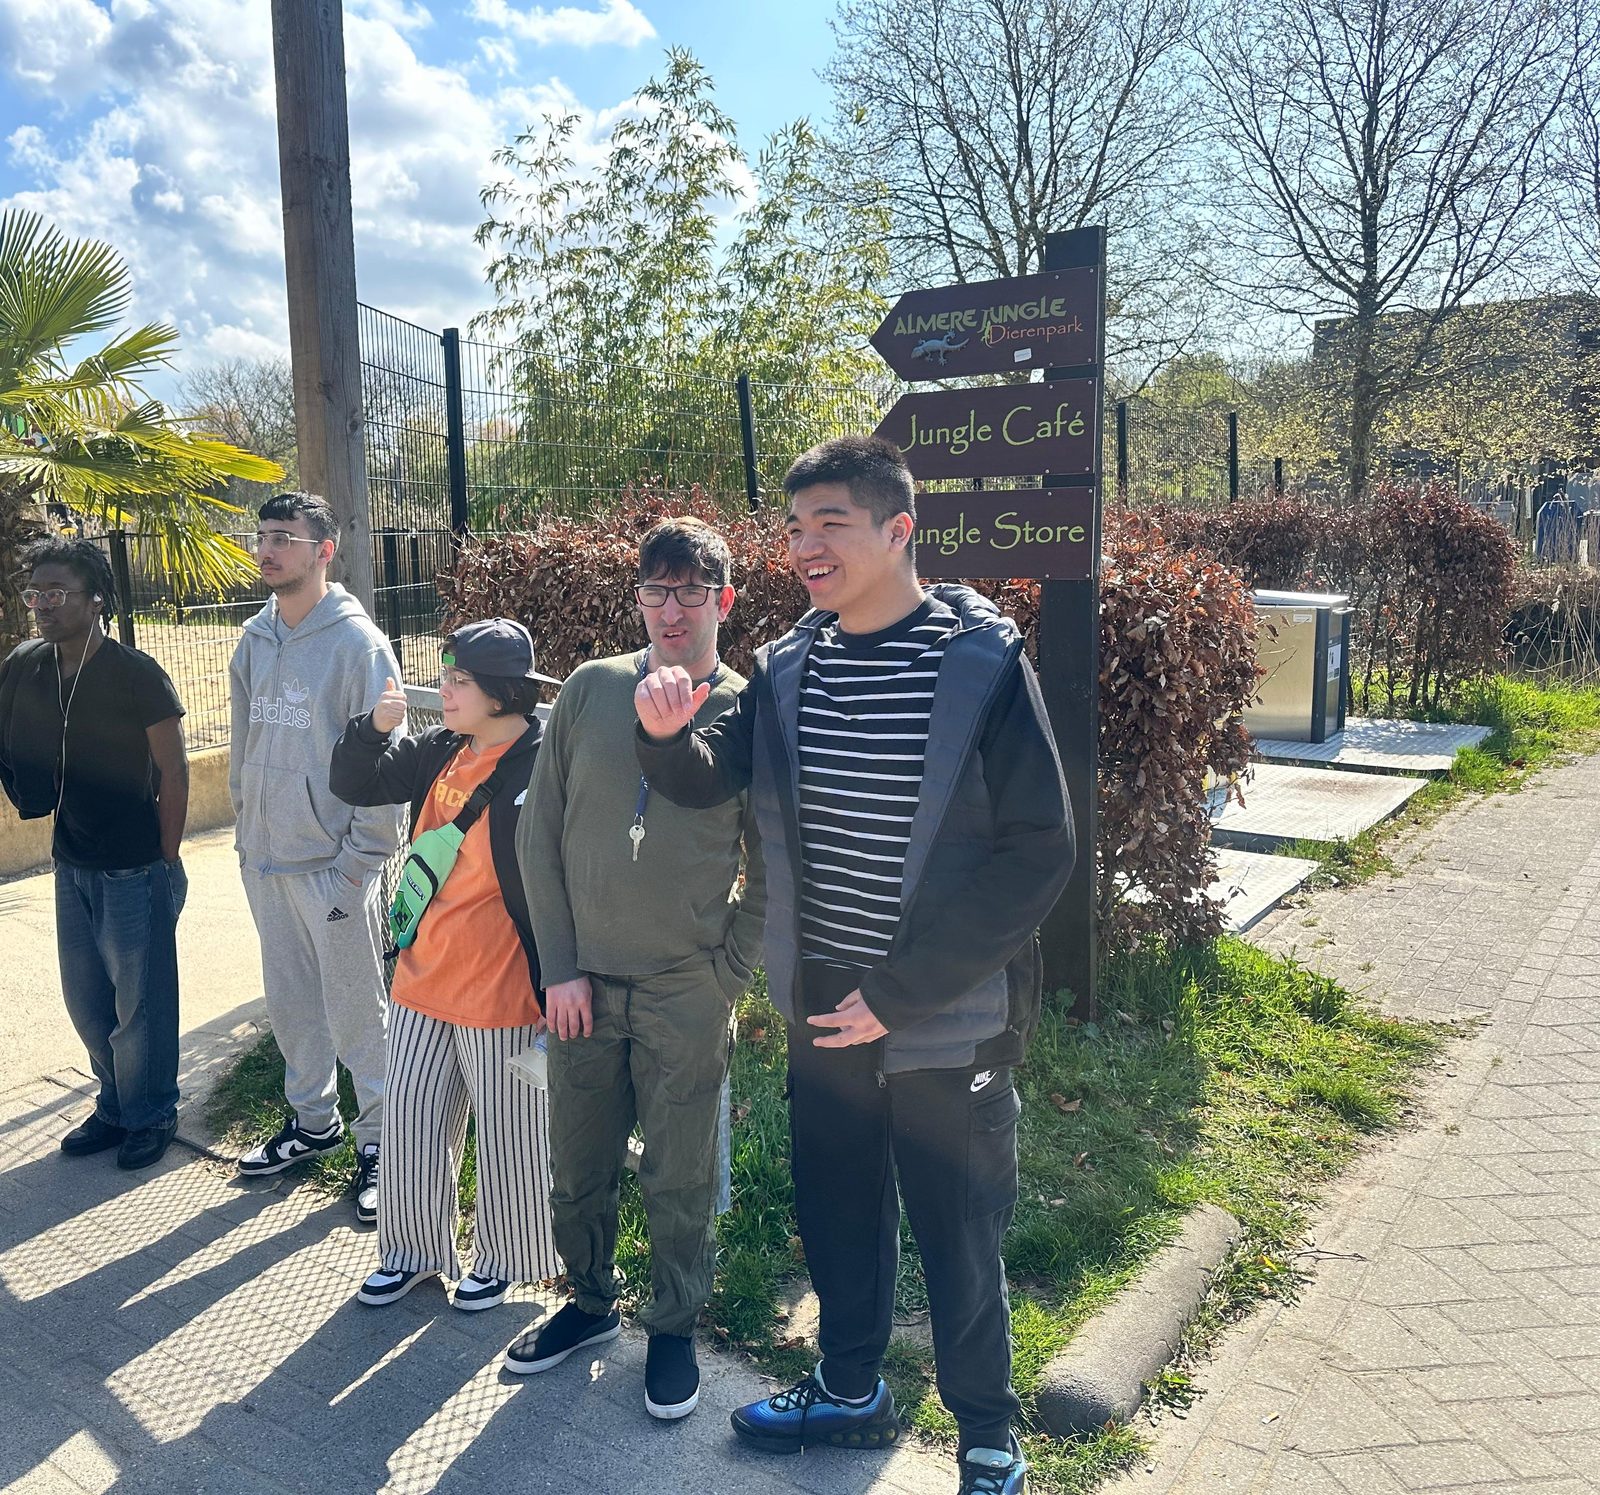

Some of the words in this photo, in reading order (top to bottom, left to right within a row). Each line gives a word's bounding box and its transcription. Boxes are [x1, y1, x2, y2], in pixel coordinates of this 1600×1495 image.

[893, 309, 977, 336] ALMERE
[977, 296, 1067, 334] JUNGLE
[989, 315, 1084, 345] Dierenpark
[898, 410, 992, 455] Jungle
[1002, 402, 1085, 446] Café
[915, 512, 981, 555] ungle
[989, 511, 1085, 550] Store
[250, 696, 311, 729] didas
[974, 1070, 991, 1085] NIKE
